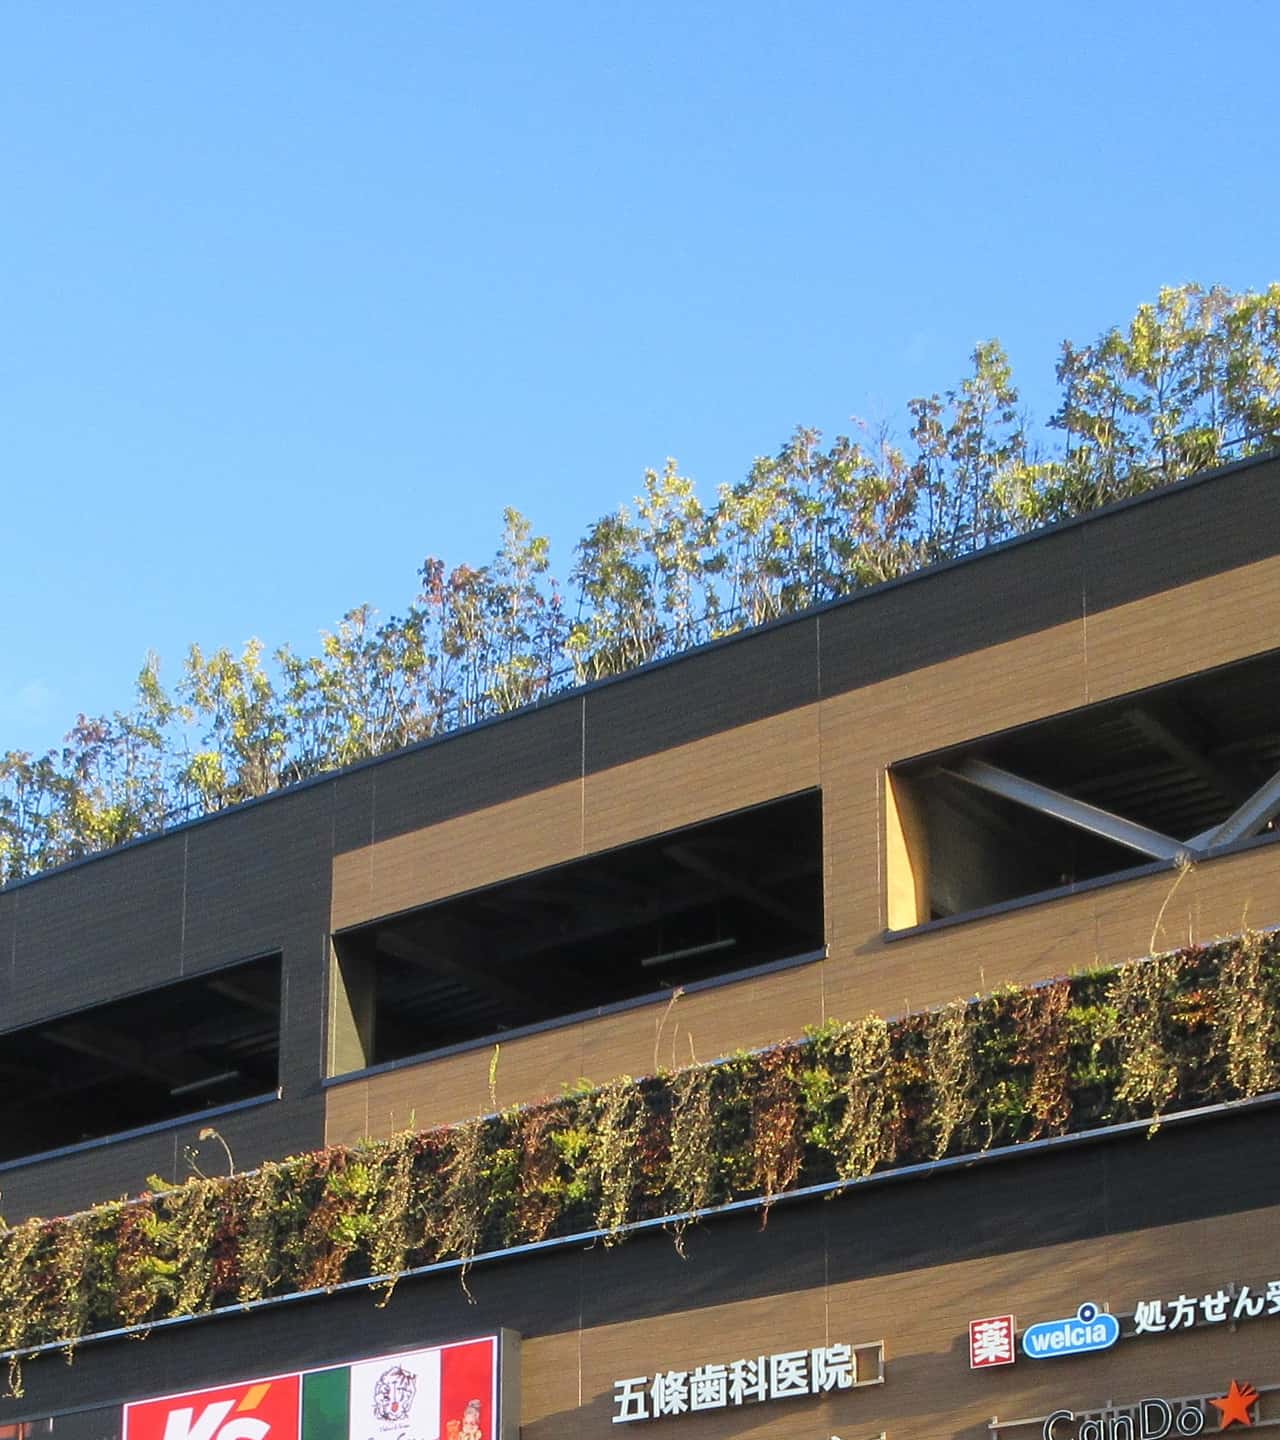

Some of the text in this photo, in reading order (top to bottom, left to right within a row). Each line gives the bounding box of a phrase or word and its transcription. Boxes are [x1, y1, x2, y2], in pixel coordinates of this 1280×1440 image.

[973, 1321, 1011, 1363] 薬
[1032, 1323, 1107, 1352] welcia
[612, 1343, 856, 1423] 五條歯科医院
